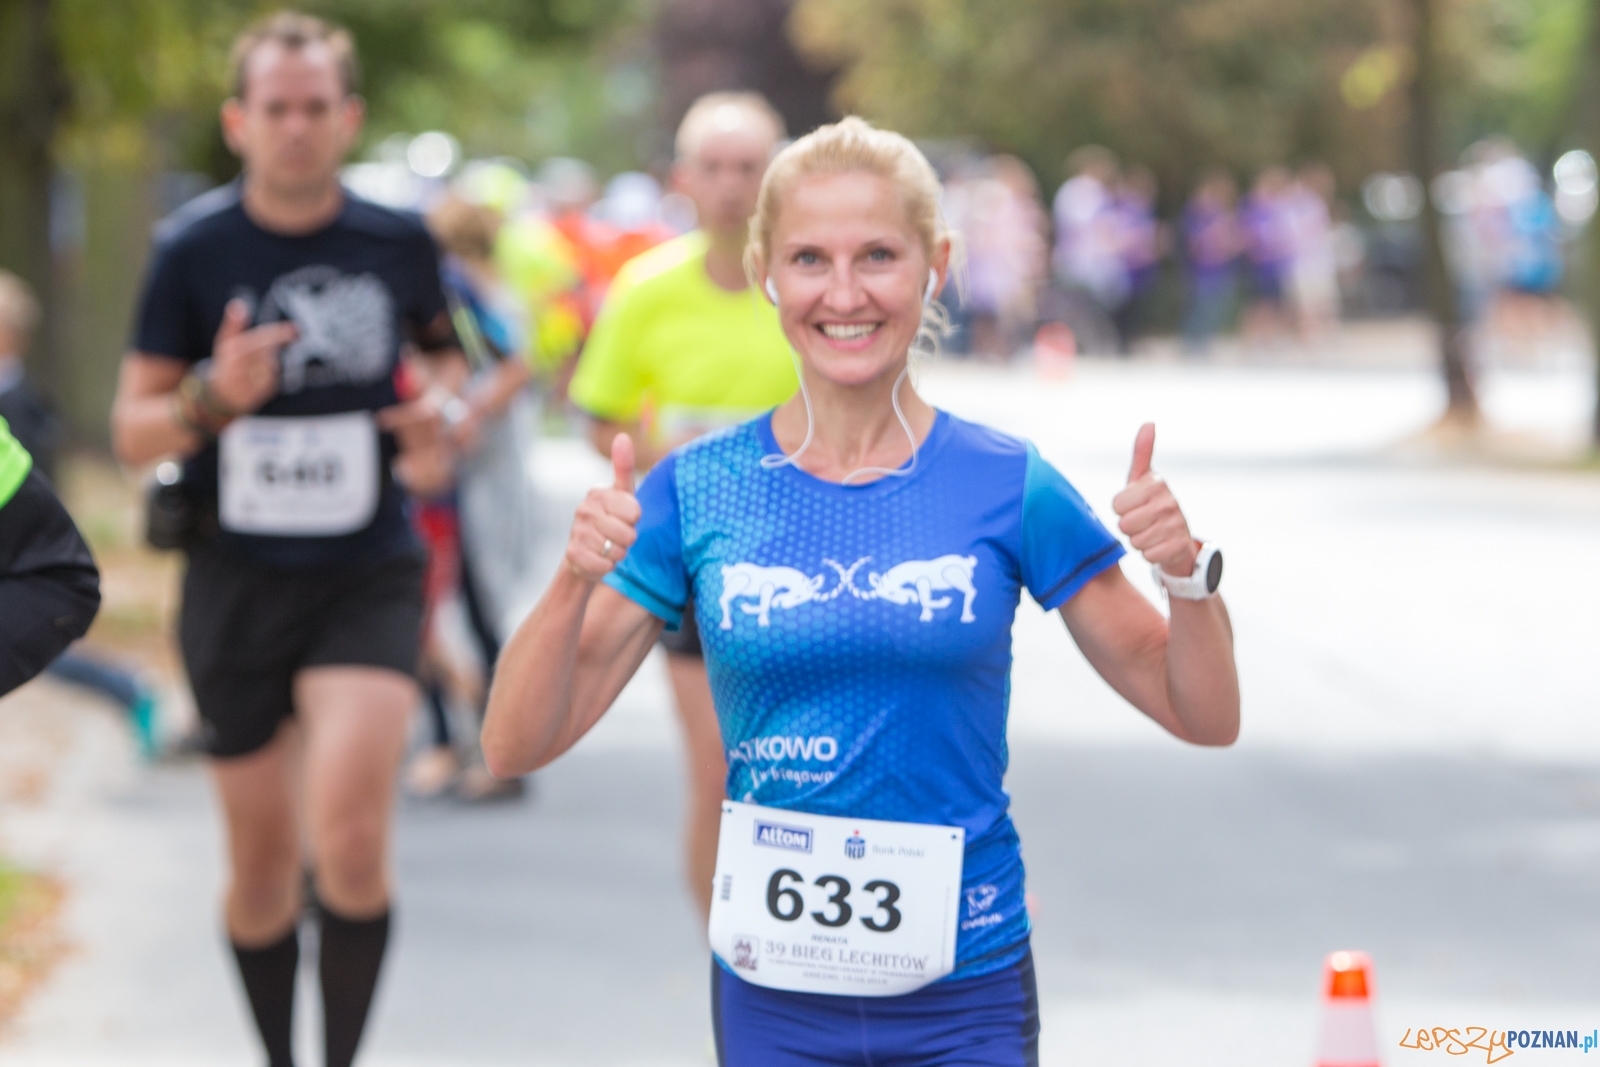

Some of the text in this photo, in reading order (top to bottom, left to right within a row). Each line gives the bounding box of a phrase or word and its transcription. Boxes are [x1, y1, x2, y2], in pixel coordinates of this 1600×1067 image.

[766, 868, 902, 933] 633
[766, 941, 786, 957] 39
[792, 944, 832, 961] BIEG
[838, 949, 928, 971] LECHITÓW
